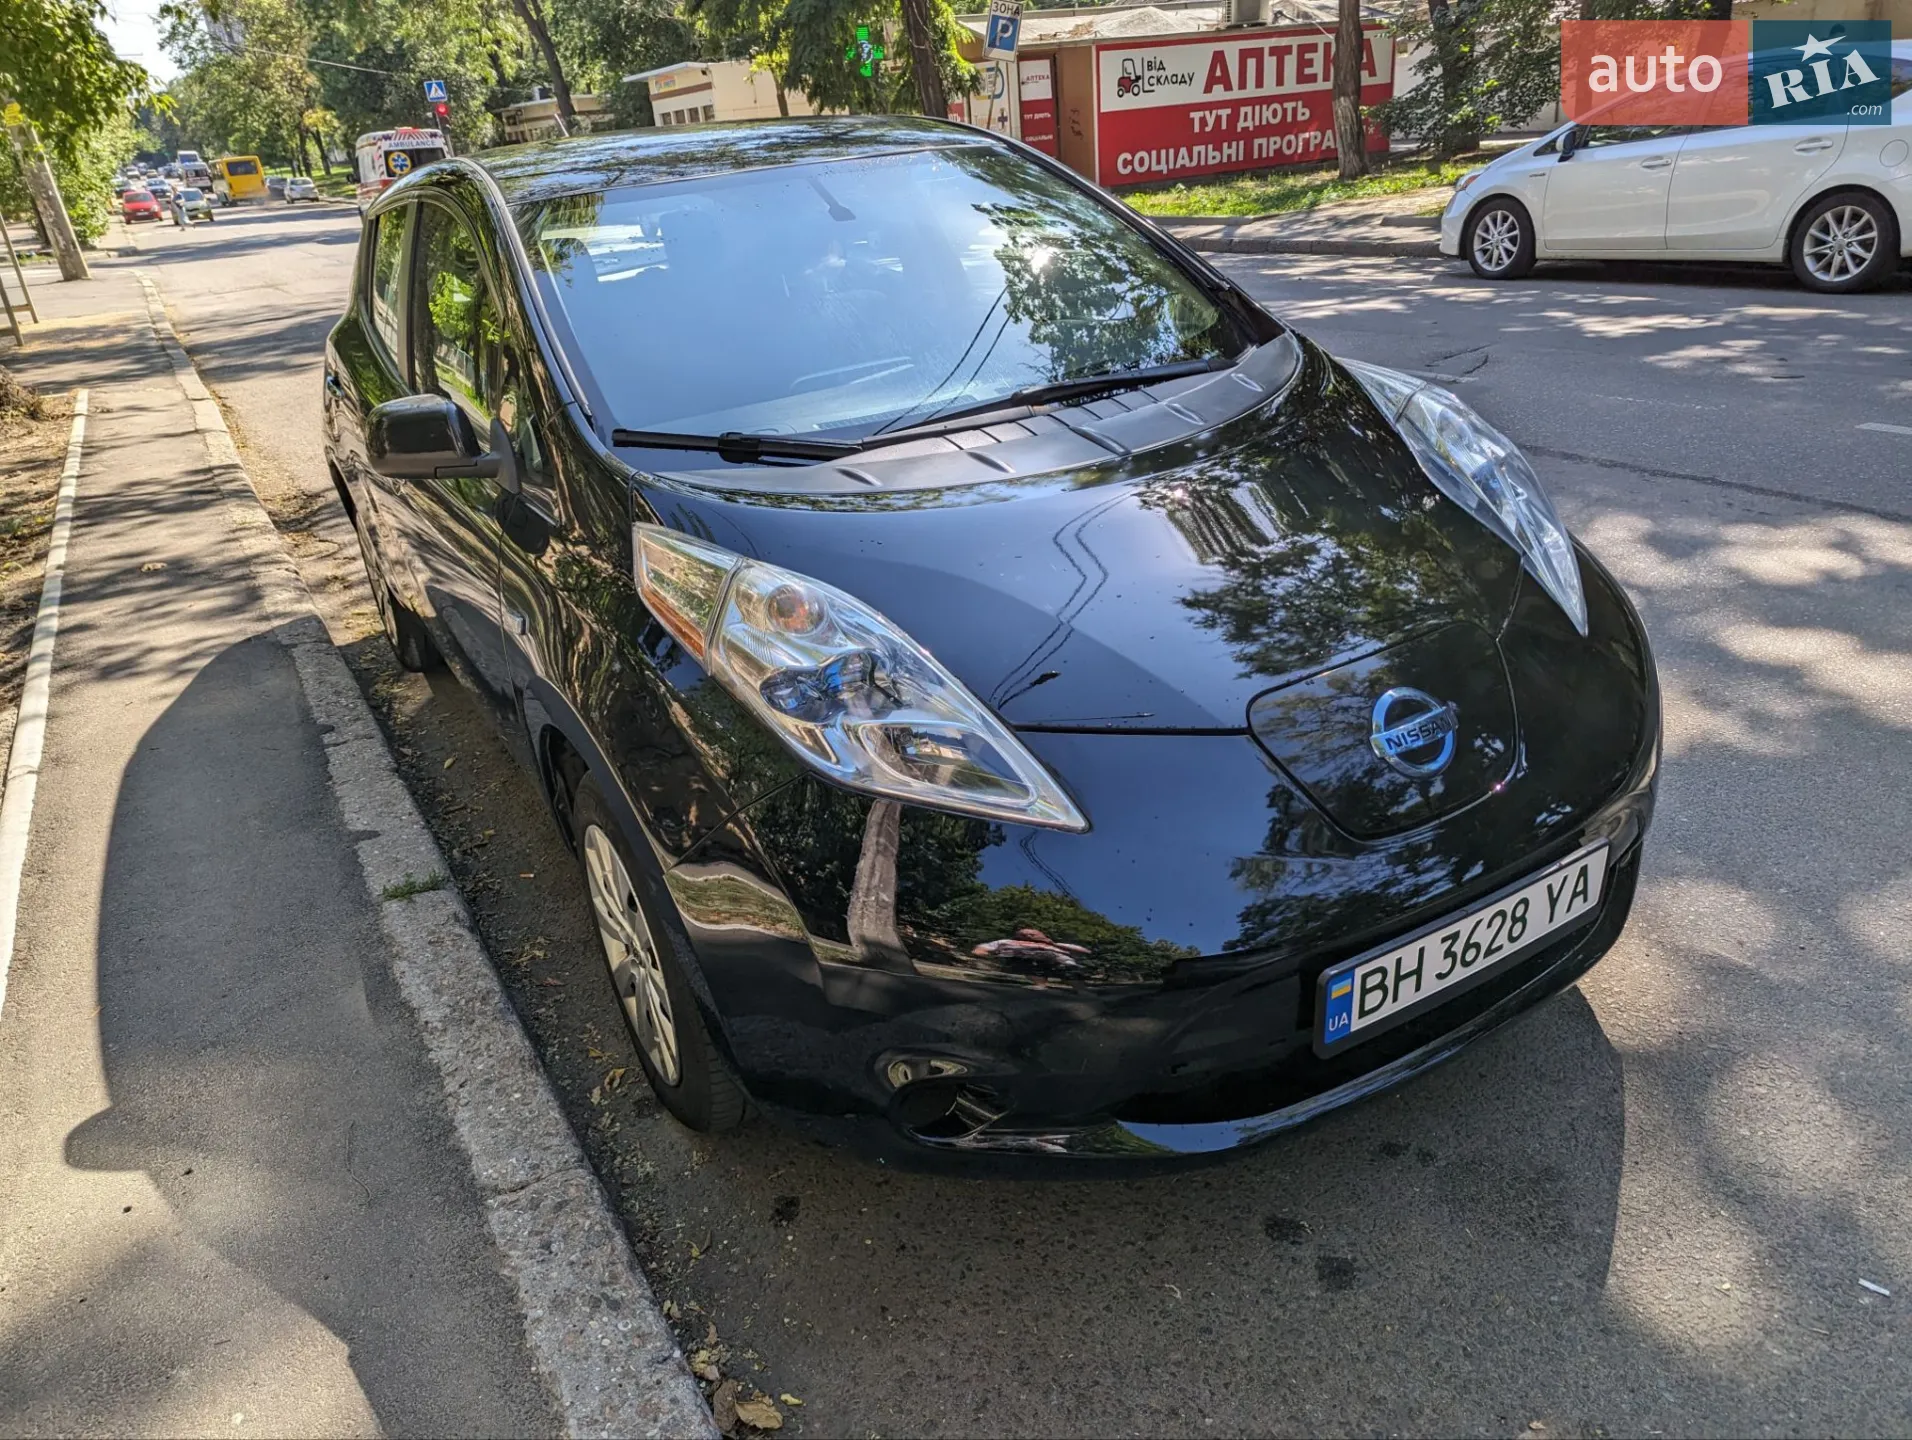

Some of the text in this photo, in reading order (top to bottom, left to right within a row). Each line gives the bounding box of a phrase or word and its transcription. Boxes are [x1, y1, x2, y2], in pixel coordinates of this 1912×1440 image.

[992, 2, 1020, 17] ЗОНА
[995, 19, 1013, 46] P
[1190, 100, 1310, 133] ТУТ ДІЮТЬ
[388, 140, 437, 149] AMBULANCE
[1117, 140, 1244, 175] СОЦІАЛЬНІ
[1384, 716, 1450, 751] NISSAN
[1358, 946, 1425, 1020] BH
[1435, 897, 1530, 981] 3628
[1328, 1014, 1350, 1032] UA
